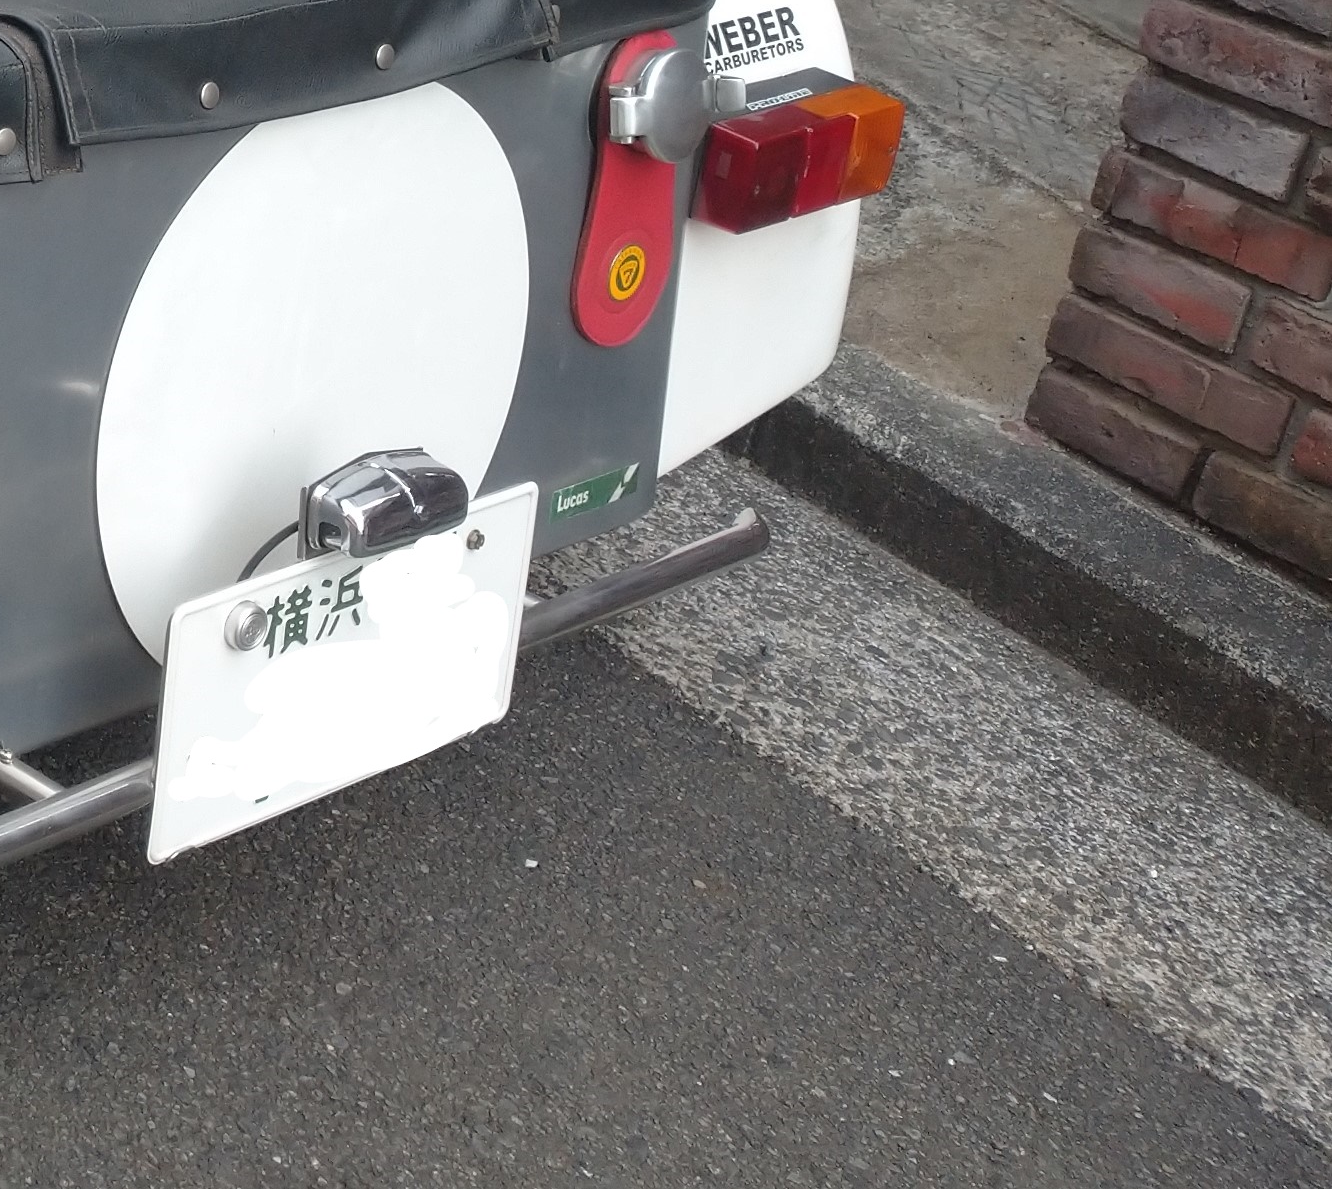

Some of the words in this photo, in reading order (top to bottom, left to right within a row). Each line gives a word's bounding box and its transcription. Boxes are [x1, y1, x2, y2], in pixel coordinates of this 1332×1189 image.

[705, 37, 805, 74] CARBURETORS
[556, 490, 590, 513] Lucas
[263, 564, 364, 659] 横浜
